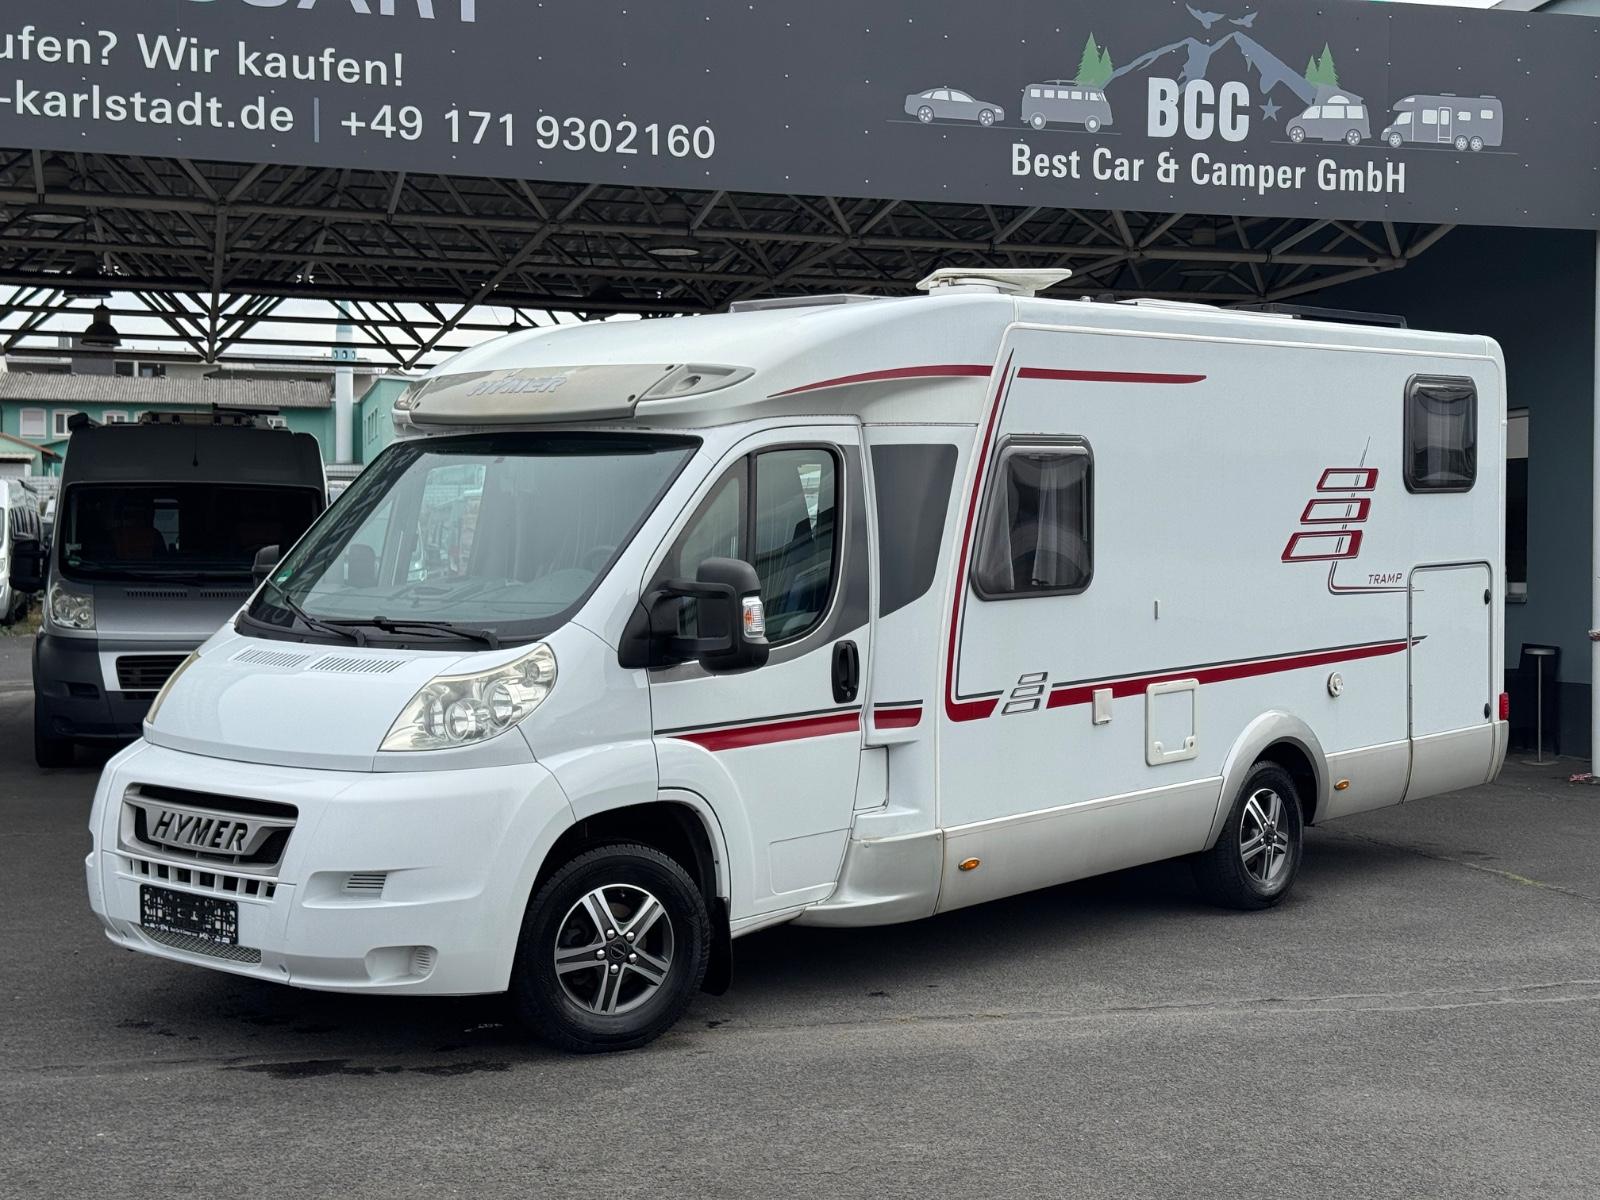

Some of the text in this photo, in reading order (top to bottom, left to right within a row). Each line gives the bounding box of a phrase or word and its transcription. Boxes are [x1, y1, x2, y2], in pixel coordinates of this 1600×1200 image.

[137, 33, 220, 73] Wir
[238, 40, 403, 87] kaufen!
[341, 105, 423, 141] +49
[444, 109, 513, 147] 171
[536, 115, 716, 159] 9302160
[1147, 76, 1250, 142] BCC
[1012, 143, 1406, 196] Best Car & Camper GmbH
[1368, 572, 1403, 585] TRAMP
[152, 810, 249, 852] HYMER
